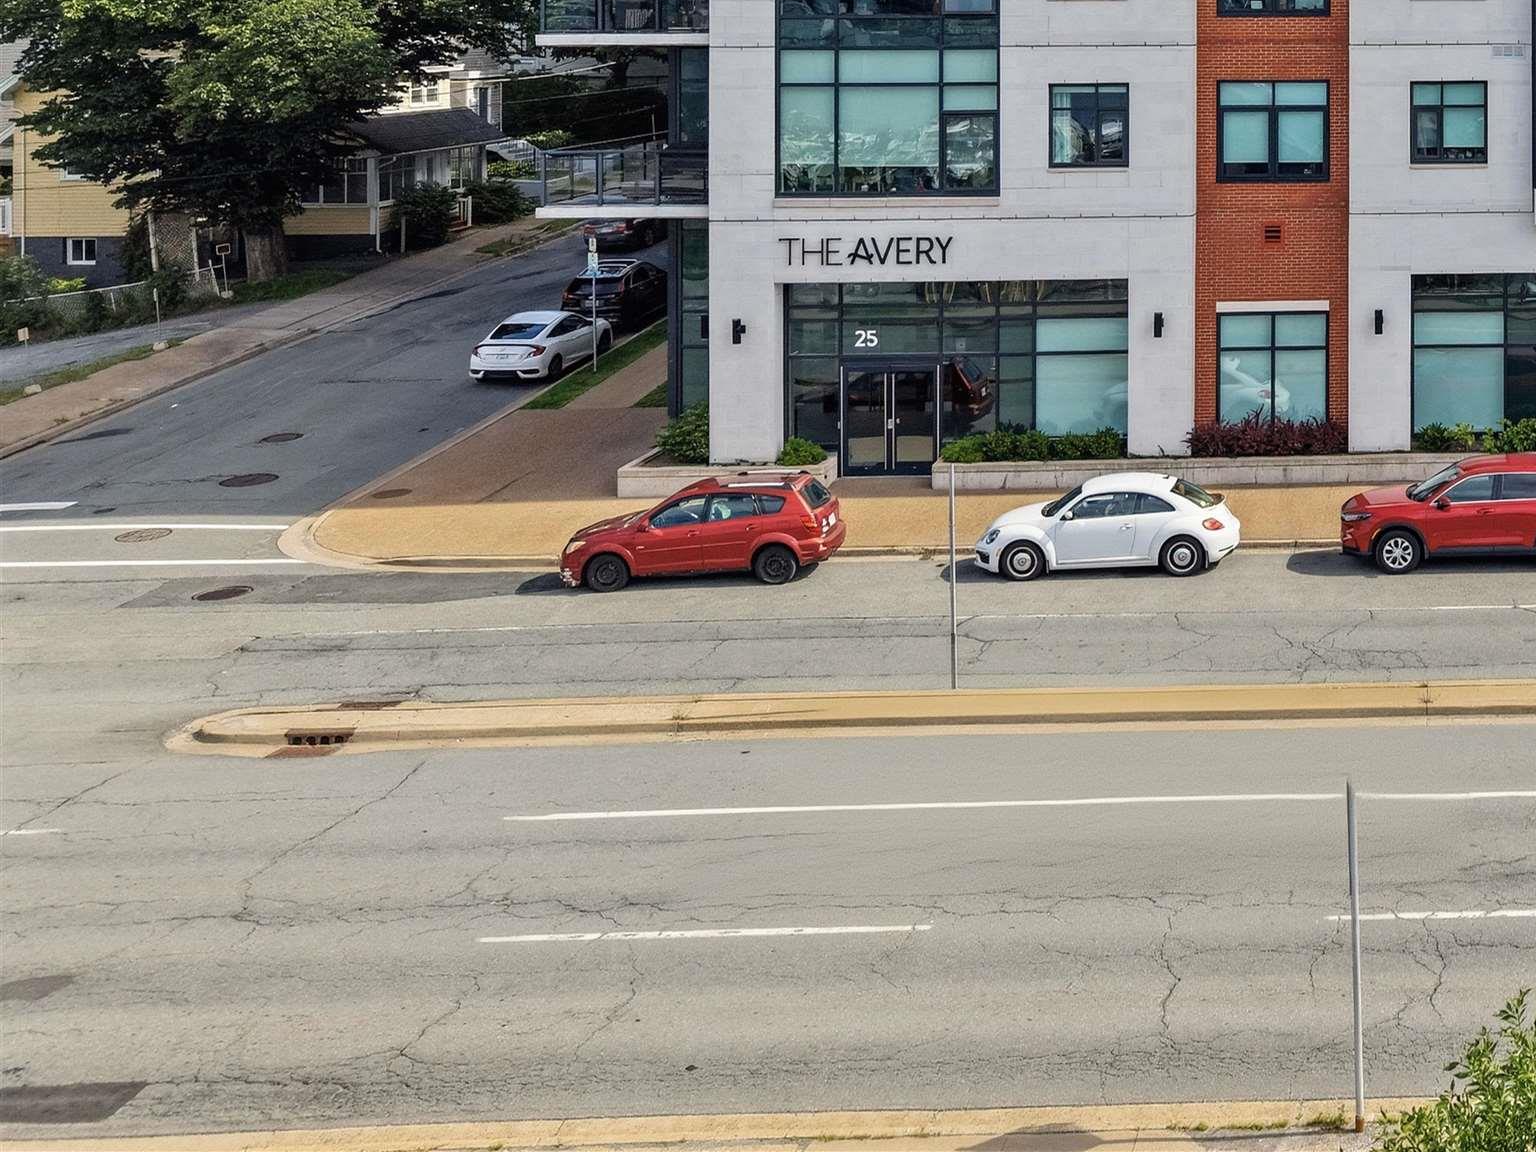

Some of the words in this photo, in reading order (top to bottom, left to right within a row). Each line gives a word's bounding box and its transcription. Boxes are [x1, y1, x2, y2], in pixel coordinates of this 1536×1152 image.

[778, 236, 844, 266] THE
[847, 235, 954, 266] AVERY
[854, 329, 879, 348] 25
